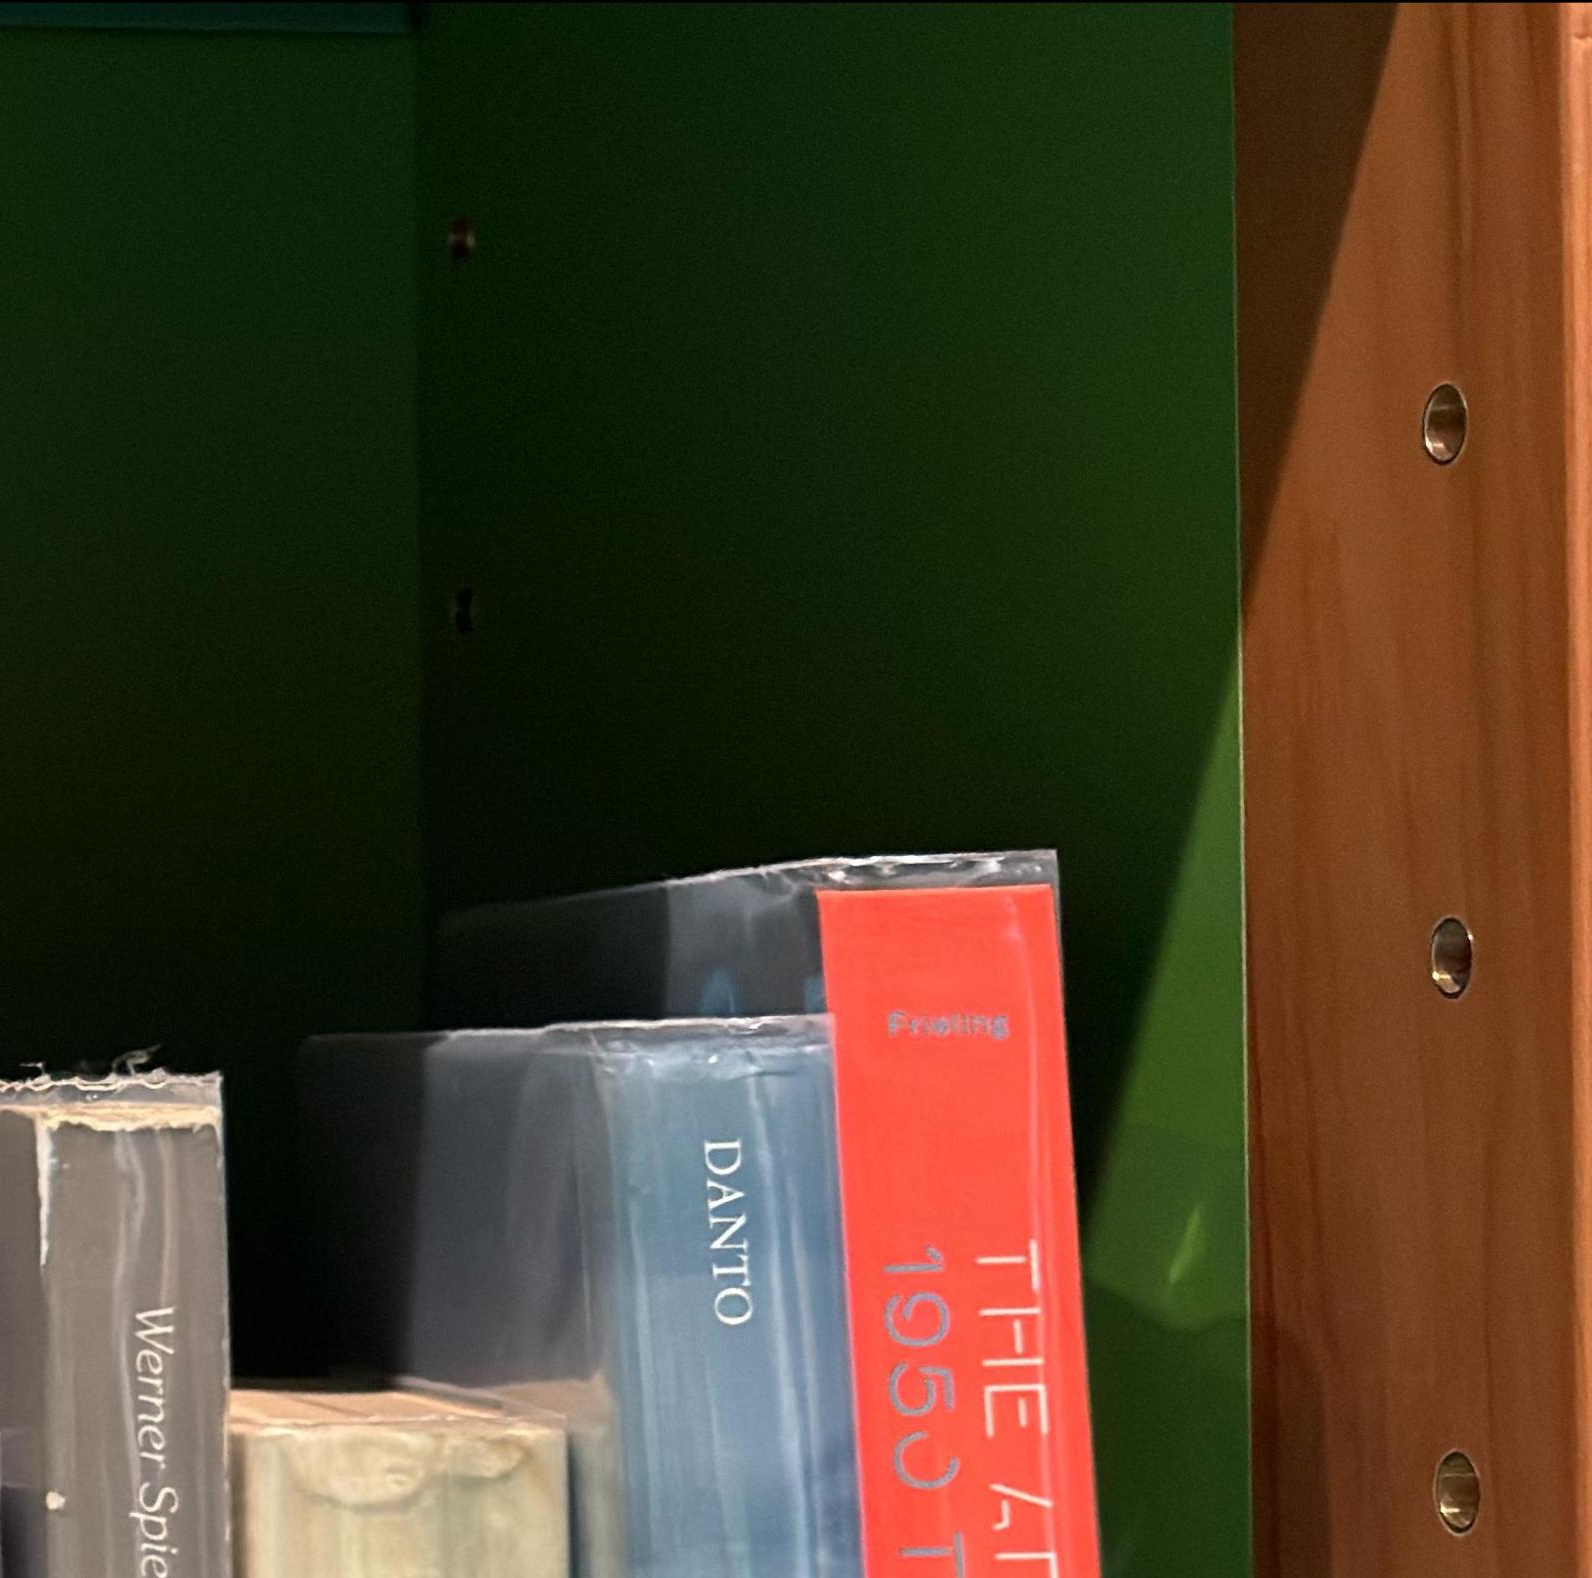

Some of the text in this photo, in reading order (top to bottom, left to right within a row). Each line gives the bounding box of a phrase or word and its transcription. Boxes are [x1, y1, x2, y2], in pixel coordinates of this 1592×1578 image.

[703, 1138, 753, 1325] DANTO
[133, 1305, 177, 1472] Werner
[975, 1240, 1053, 1437] THE
